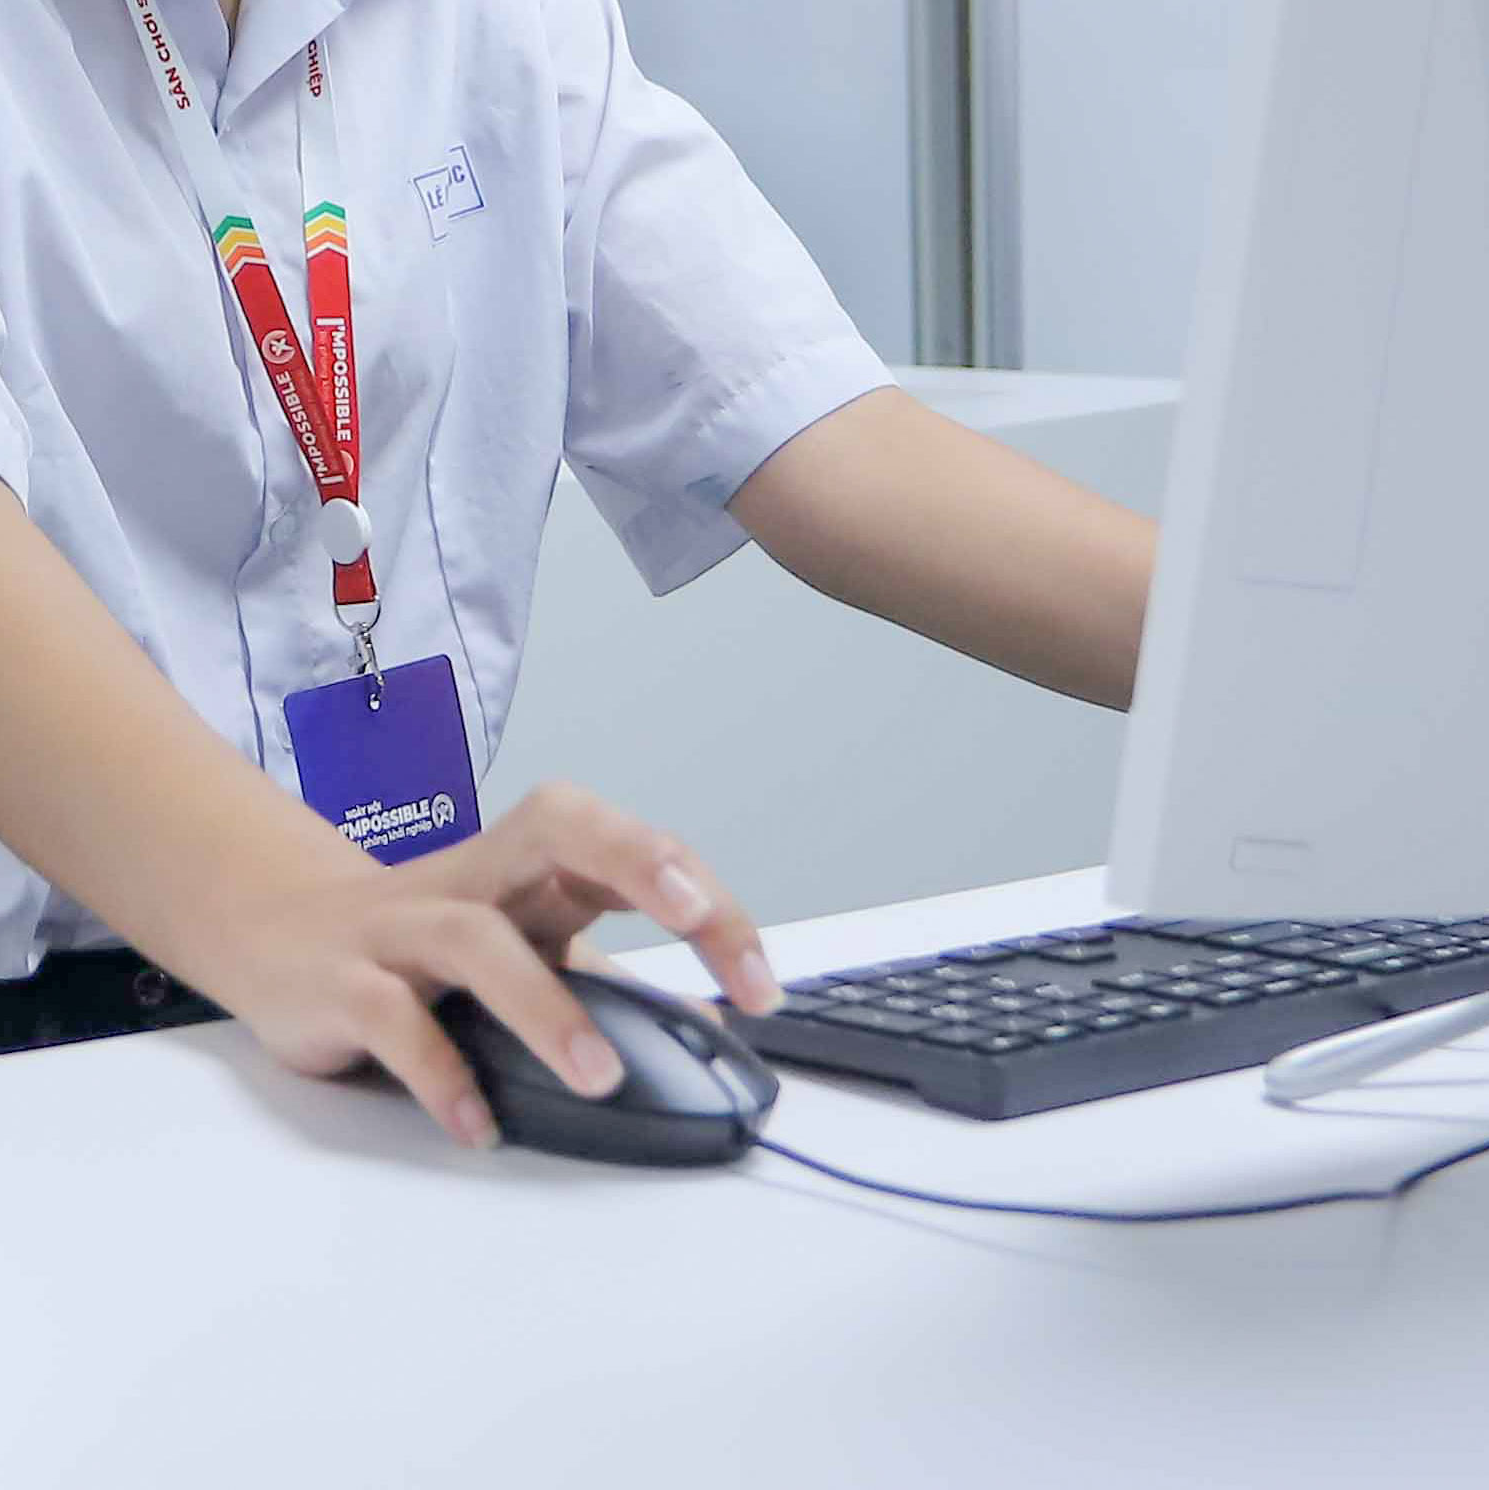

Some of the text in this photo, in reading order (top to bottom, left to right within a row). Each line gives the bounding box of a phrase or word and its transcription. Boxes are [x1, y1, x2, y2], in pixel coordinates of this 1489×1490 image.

[142, 13, 171, 62] CHƠI
[305, 40, 324, 98] GHIỆP
[316, 317, 352, 442] I'MPOSSIBLE
[275, 370, 345, 485] I'MPOSSIBLE
